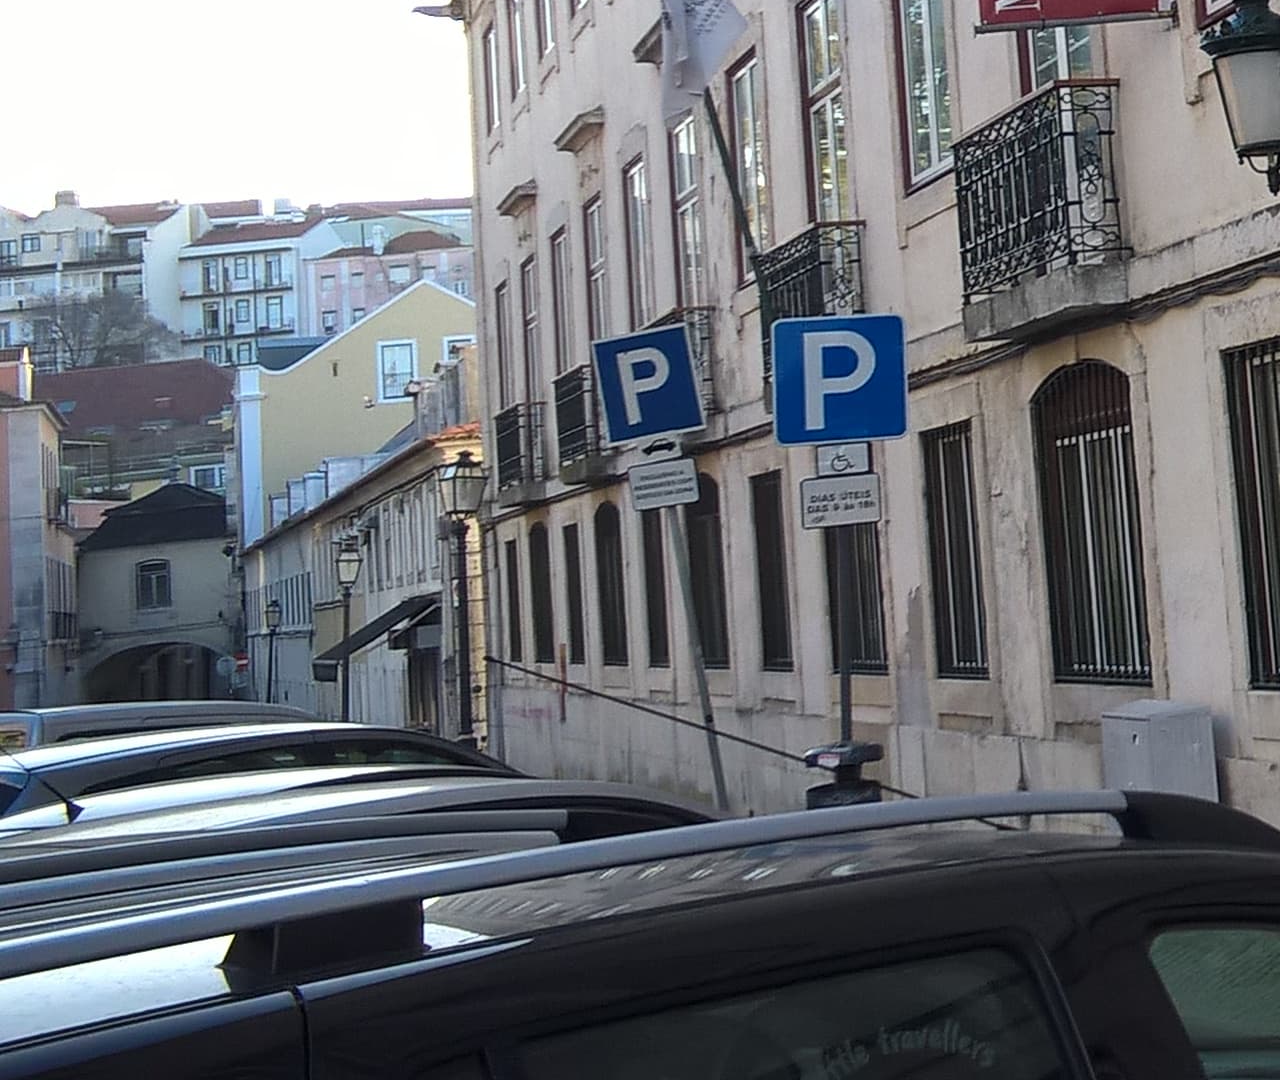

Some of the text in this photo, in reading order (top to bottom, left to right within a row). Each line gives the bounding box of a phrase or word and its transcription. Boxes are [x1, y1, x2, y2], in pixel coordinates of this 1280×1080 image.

[616, 347, 670, 426] P
[803, 330, 876, 431] P
[807, 503, 829, 514] DAS
[810, 493, 836, 503] DIAS
